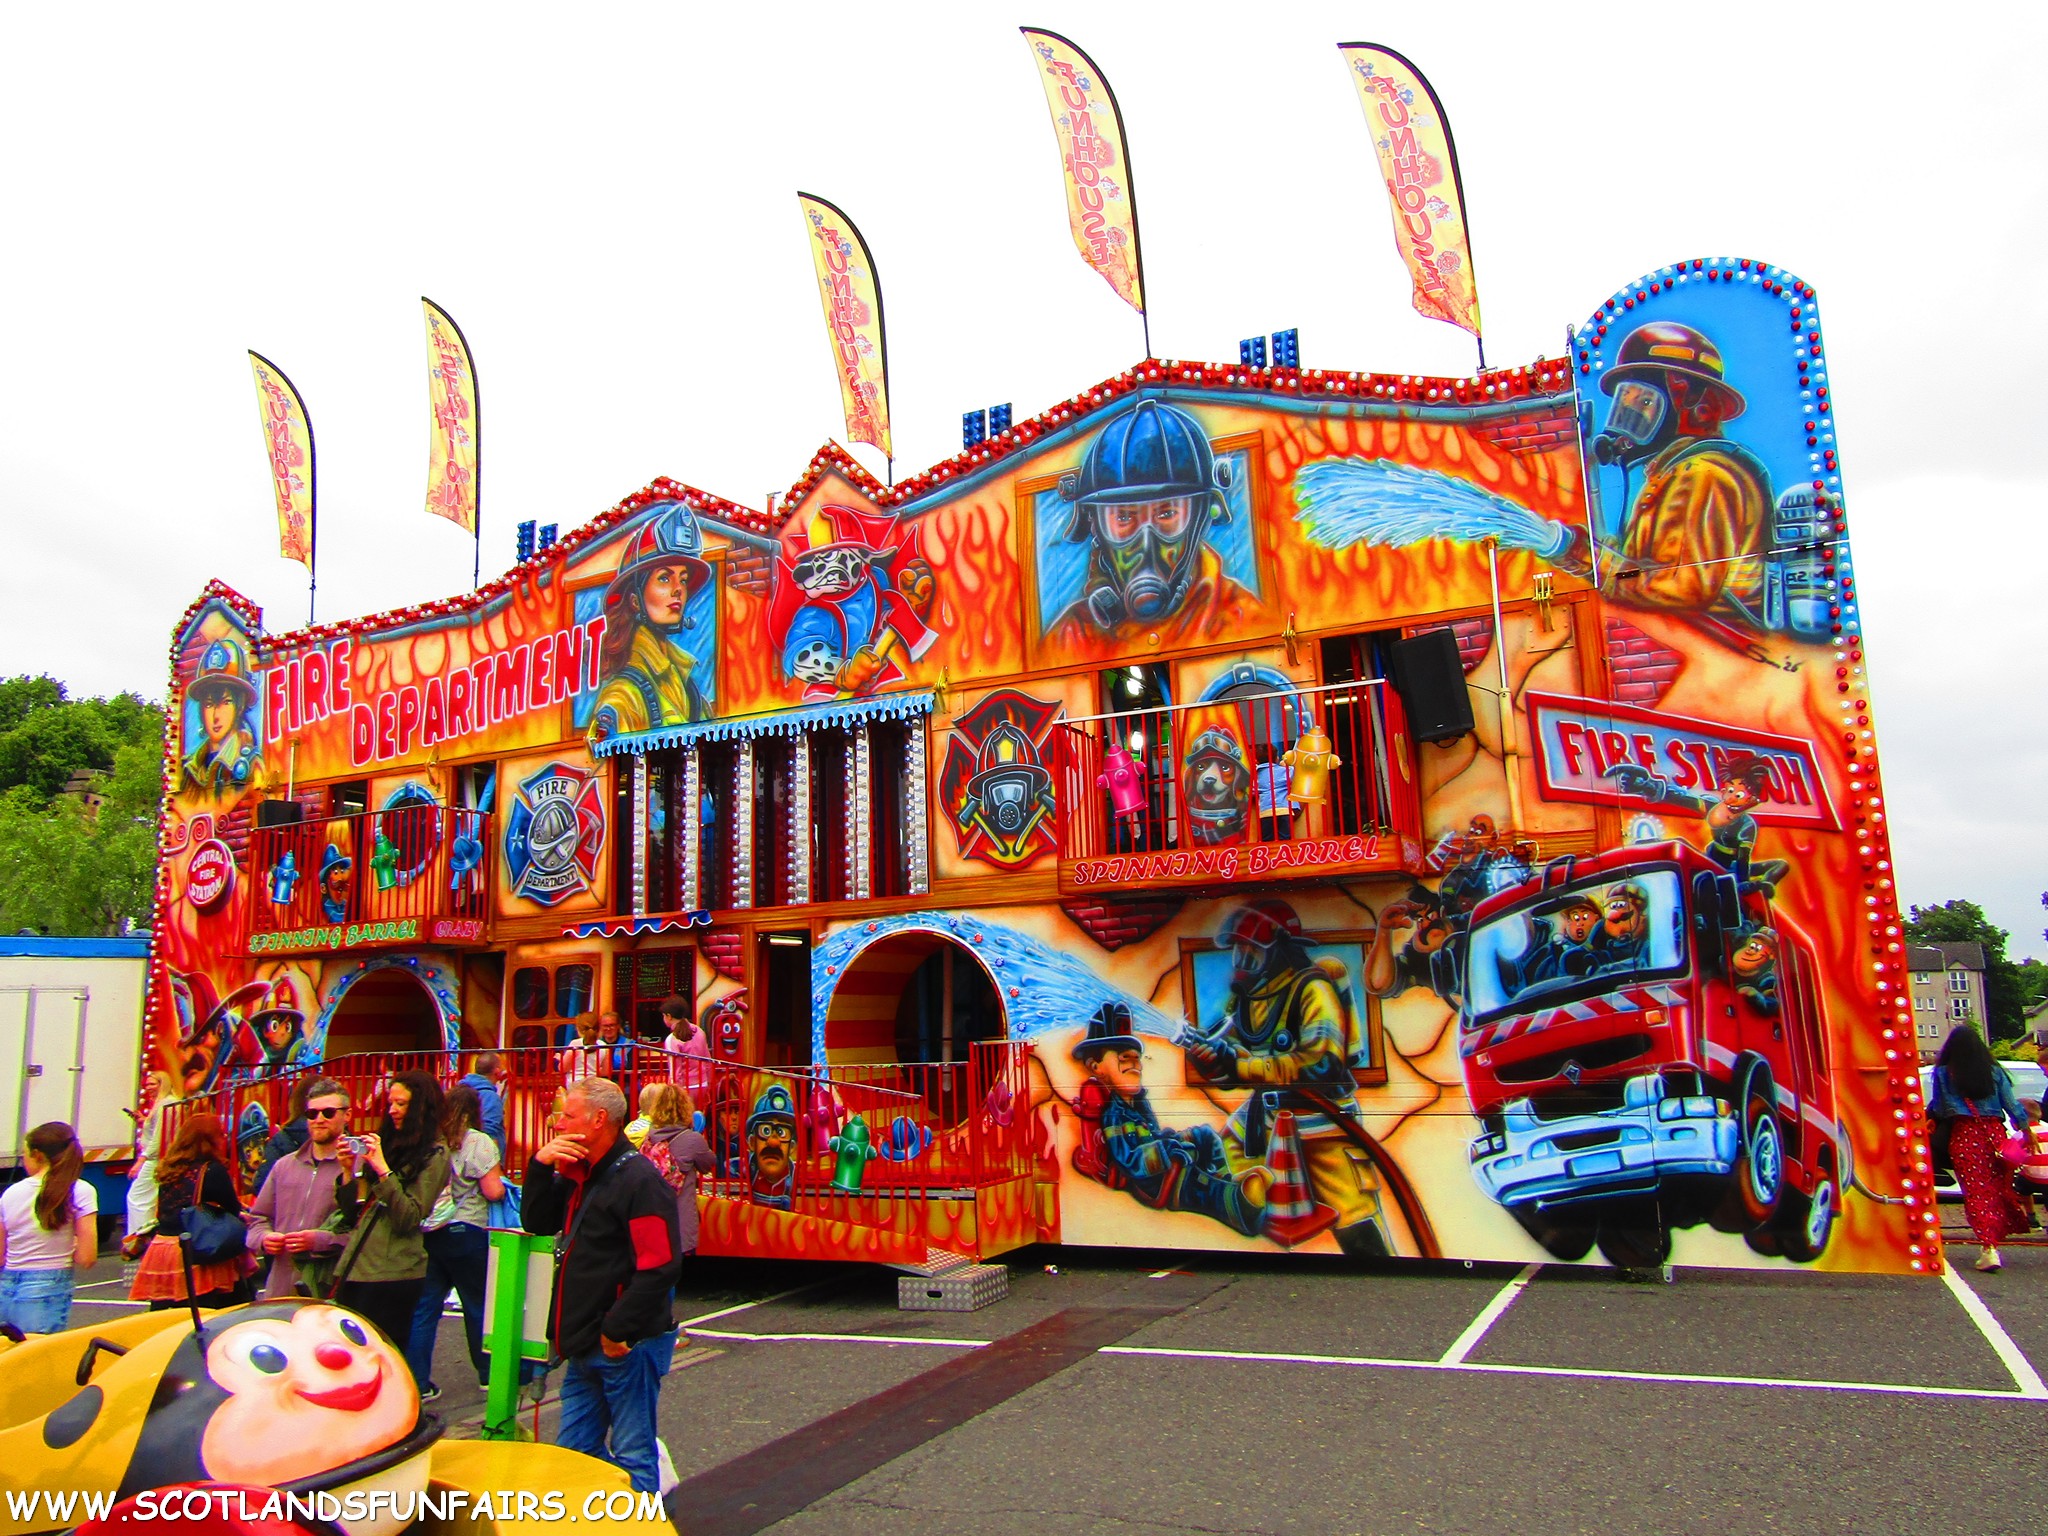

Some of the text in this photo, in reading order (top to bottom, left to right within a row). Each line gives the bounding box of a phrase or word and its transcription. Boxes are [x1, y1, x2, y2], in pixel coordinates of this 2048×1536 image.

[266, 639, 352, 744] FIRE
[351, 615, 607, 767] DEPARTMENT
[1665, 738, 1813, 805] STAON
[536, 780, 568, 799] FIRE
[191, 848, 224, 872] CENTRAL
[1073, 835, 1380, 885] SPINNING BARREL
[200, 868, 216, 880] FIRE
[526, 870, 576, 887] DEPARTMENT
[190, 876, 222, 900] STATION
[249, 919, 417, 953] SPINNING BARREL
[434, 920, 484, 940] CRAZY
